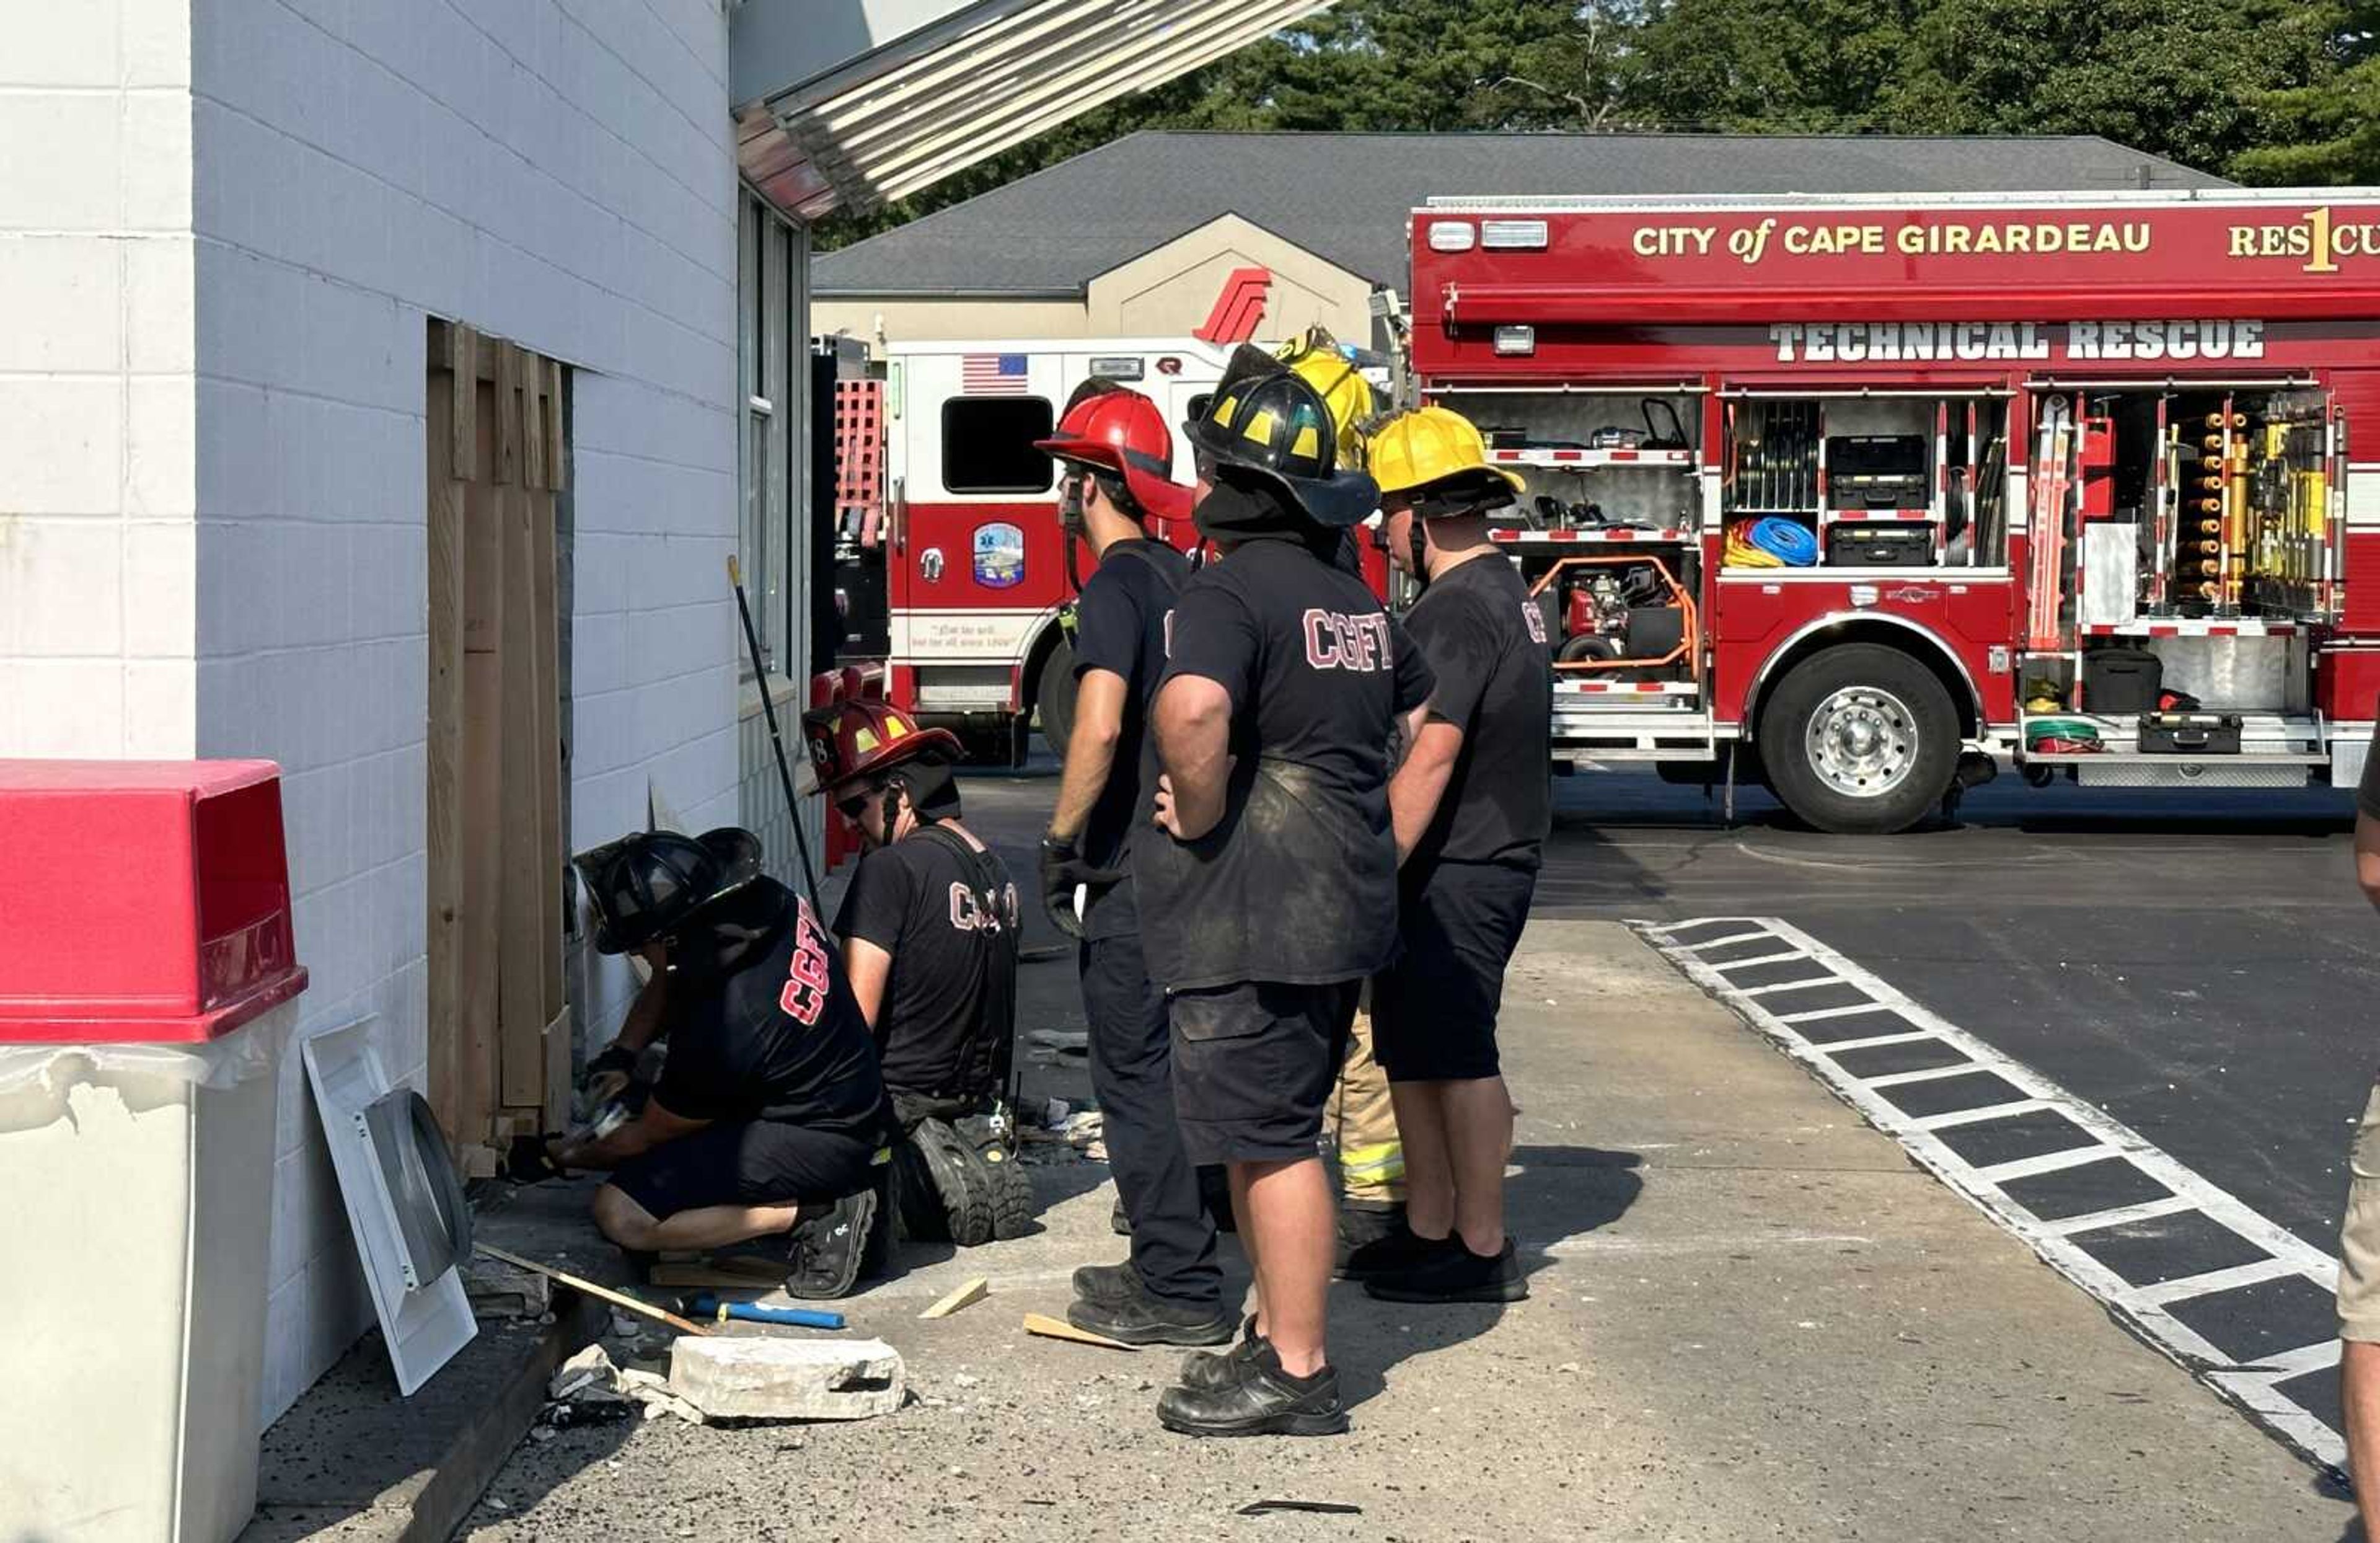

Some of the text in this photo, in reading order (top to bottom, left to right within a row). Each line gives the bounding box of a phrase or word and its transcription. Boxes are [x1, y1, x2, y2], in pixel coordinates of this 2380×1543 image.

[1632, 218, 2151, 264] CITY of CAPE GIRARDEAU
[1770, 319, 2264, 361] TECHNICAL RESCUE
